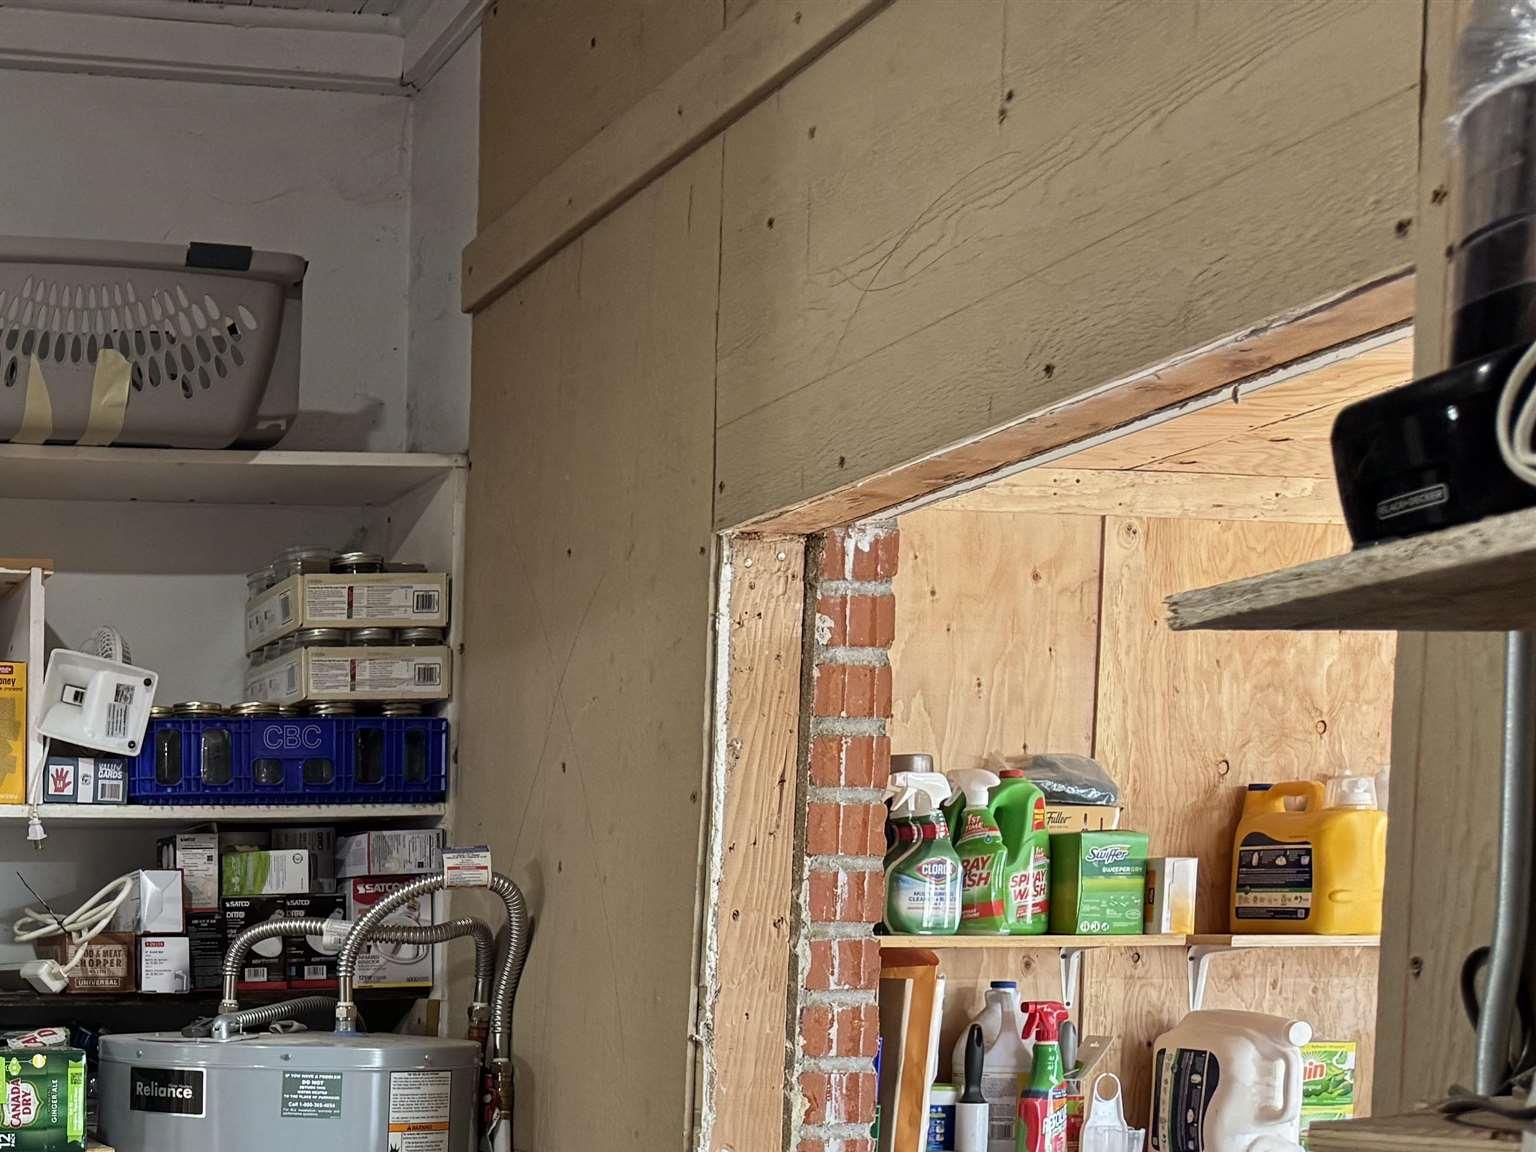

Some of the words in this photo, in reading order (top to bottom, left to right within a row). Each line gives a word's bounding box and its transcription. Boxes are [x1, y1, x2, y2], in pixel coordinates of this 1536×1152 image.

[264, 725, 322, 750] CBC
[98, 769, 123, 779] CARDS
[962, 854, 993, 871] RAY
[1086, 846, 1130, 864] Swiffer
[365, 883, 401, 894] SATCO
[102, 949, 123, 958] MEAT
[78, 978, 119, 986] UNIVERSAL
[136, 1080, 193, 1099] Reliance
[10, 1077, 21, 1129] CANADA
[22, 1089, 32, 1116] DRY
